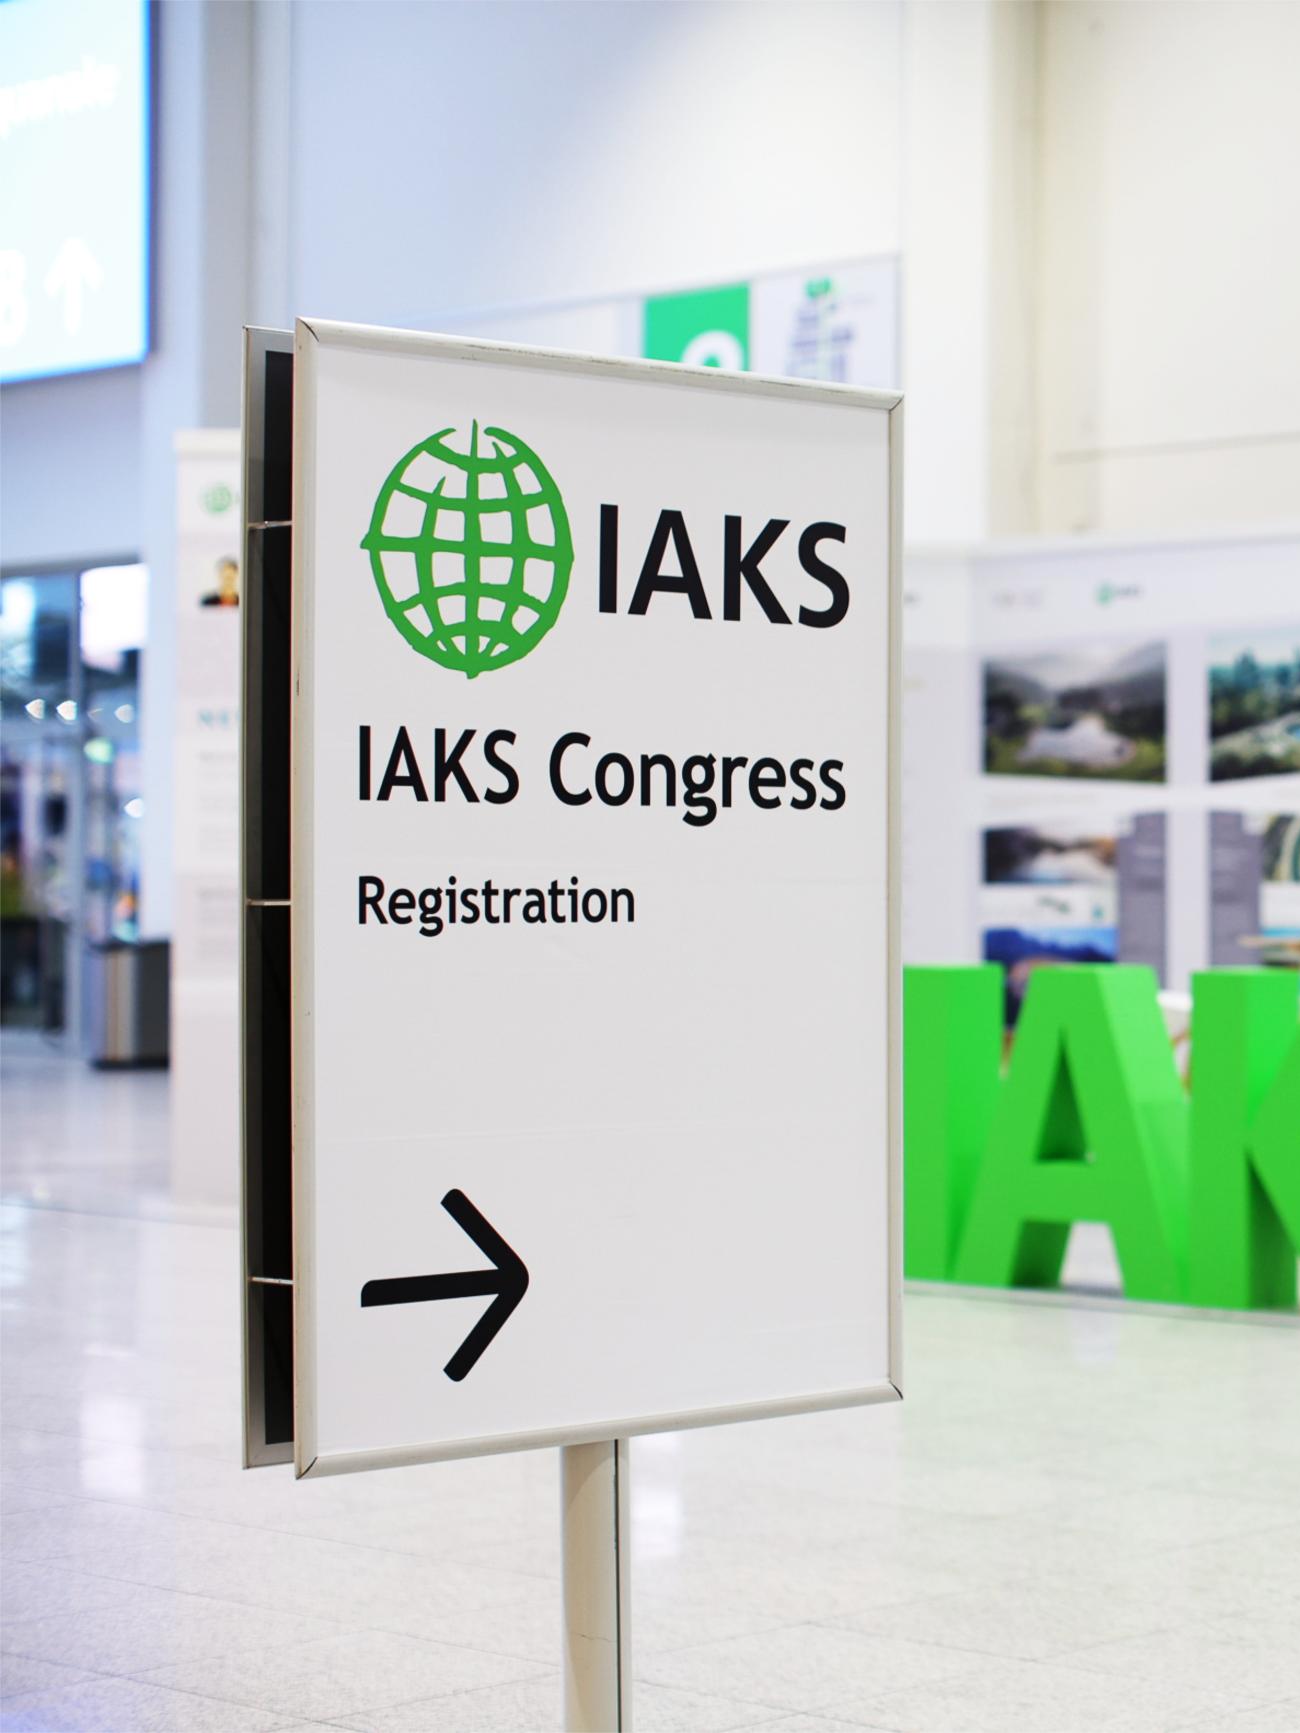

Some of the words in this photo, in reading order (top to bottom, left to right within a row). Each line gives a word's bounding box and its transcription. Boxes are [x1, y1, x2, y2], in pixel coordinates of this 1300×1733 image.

[598, 503, 850, 629] IAKS
[359, 725, 520, 805] IAKS
[549, 731, 847, 827] Congress
[358, 875, 636, 938] Registration
